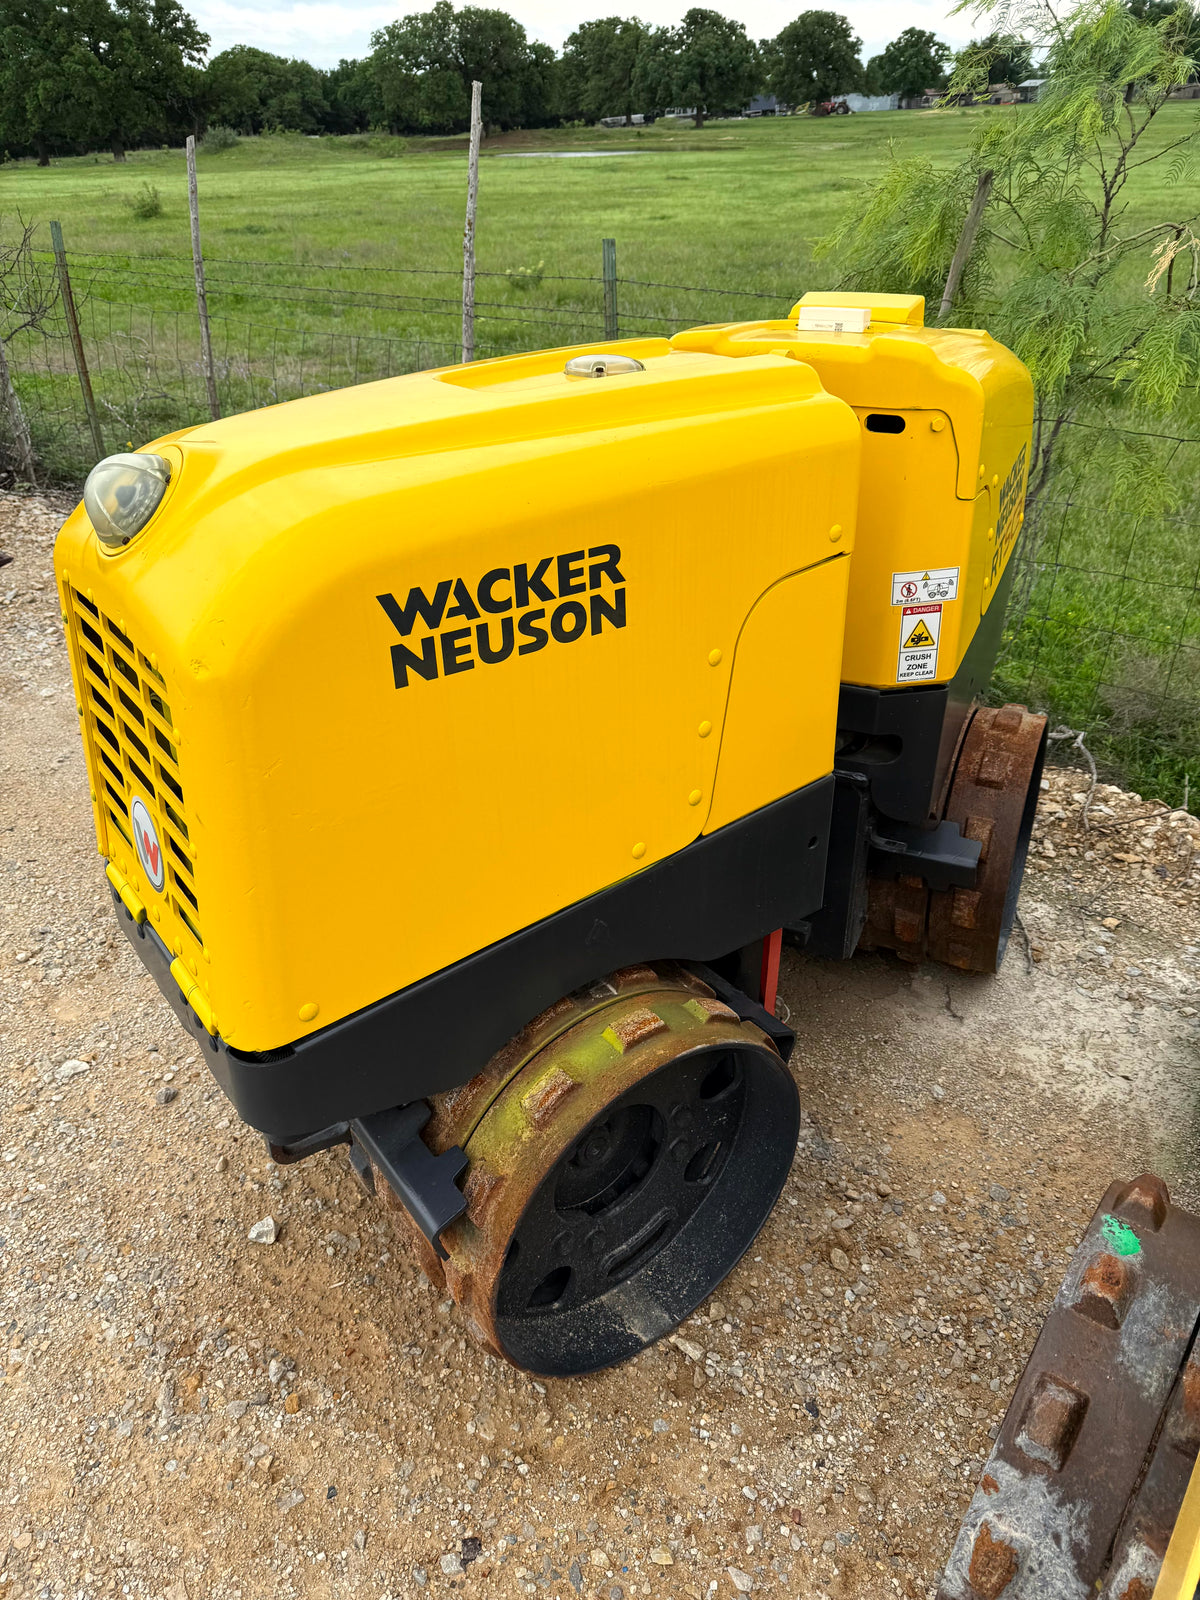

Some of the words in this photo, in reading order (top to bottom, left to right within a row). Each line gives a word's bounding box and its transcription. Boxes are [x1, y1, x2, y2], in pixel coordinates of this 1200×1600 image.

[376, 544, 626, 637] WACKER
[912, 605, 940, 614] DANGER
[390, 587, 627, 690] NEUSON
[904, 653, 932, 662] CRUSH
[906, 662, 928, 671] ZONE
